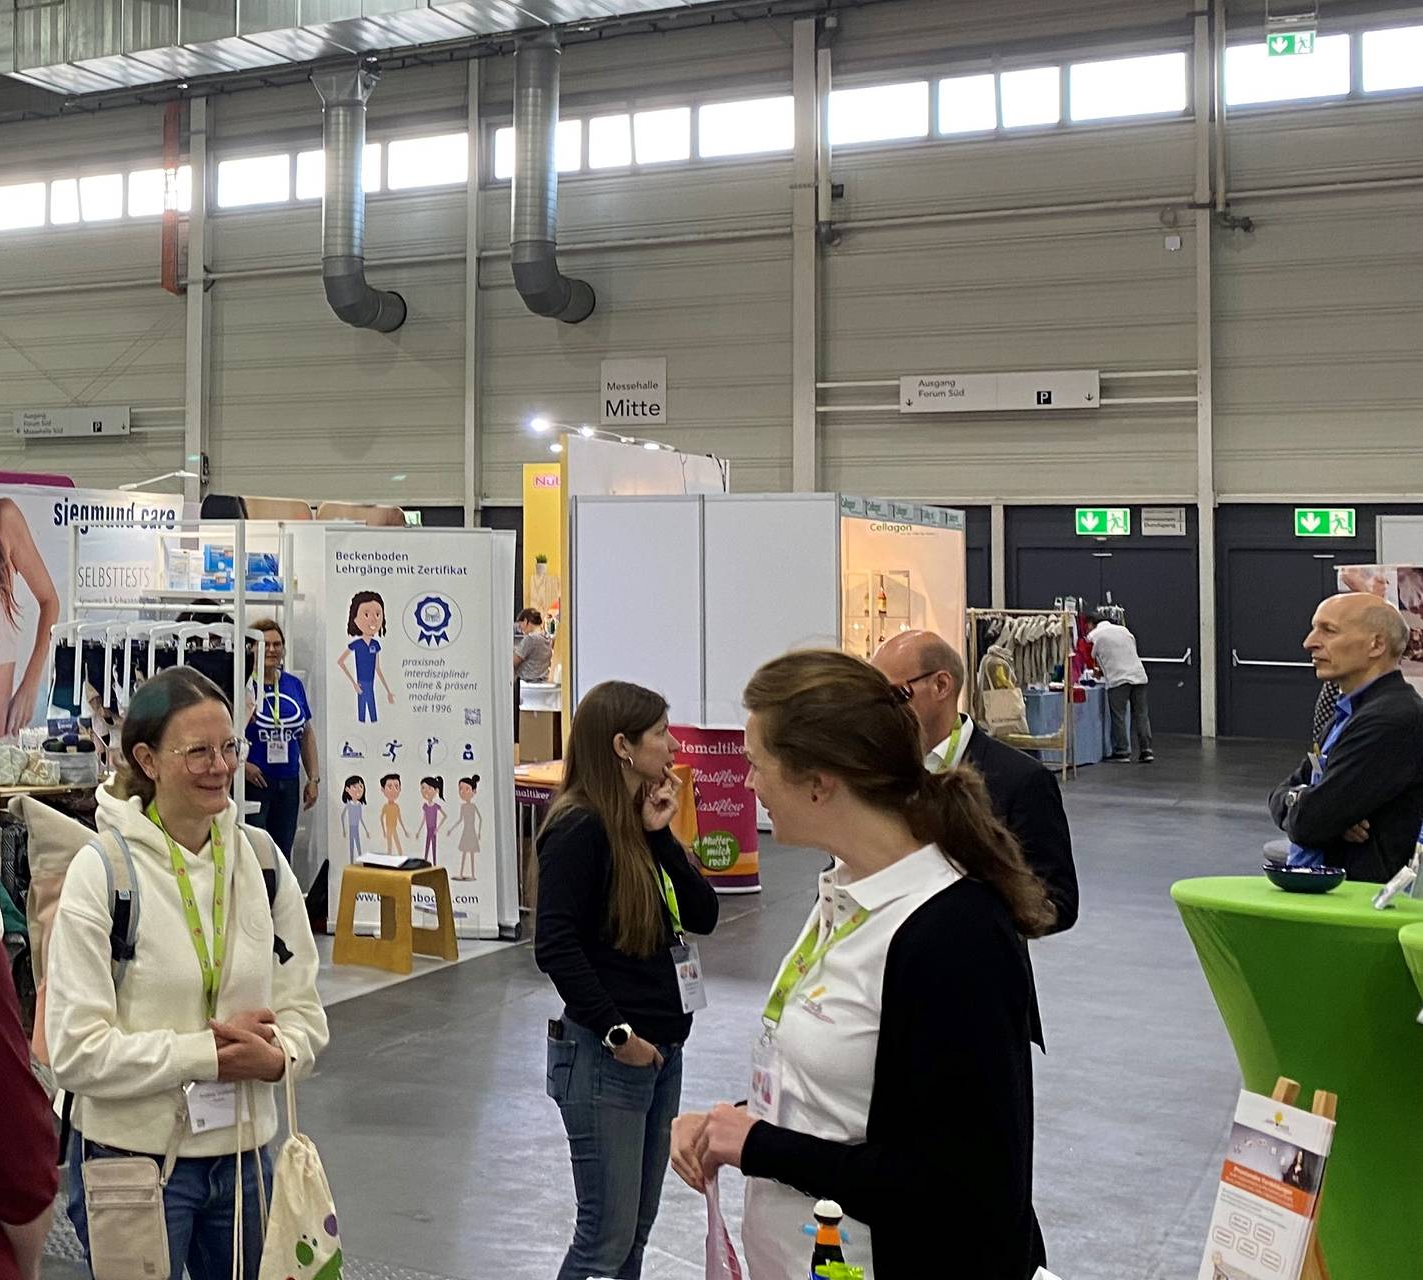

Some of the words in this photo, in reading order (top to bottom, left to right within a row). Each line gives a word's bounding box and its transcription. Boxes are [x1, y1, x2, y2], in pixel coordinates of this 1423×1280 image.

[606, 380, 659, 391] Messehalle
[918, 379, 956, 389] Ausgang
[918, 389, 946, 398] Forum
[948, 388, 965, 398] Süd
[605, 398, 661, 417] Mitte
[53, 497, 135, 535] siegmund
[140, 507, 176, 530] care
[869, 522, 913, 533] Cellagon
[335, 551, 409, 561] Beckenboden
[335, 564, 394, 576] Lehrgänge
[396, 565, 415, 575] mit
[417, 564, 468, 575] Zertifikat
[77, 566, 152, 588] SELBSTTESTS
[402, 658, 446, 668] praxisnah
[406, 681, 434, 690] online
[435, 681, 442, 690] &
[408, 692, 446, 701] modular
[412, 704, 428, 713] seit
[431, 704, 452, 713] 1996
[681, 740, 746, 755] femaltike
